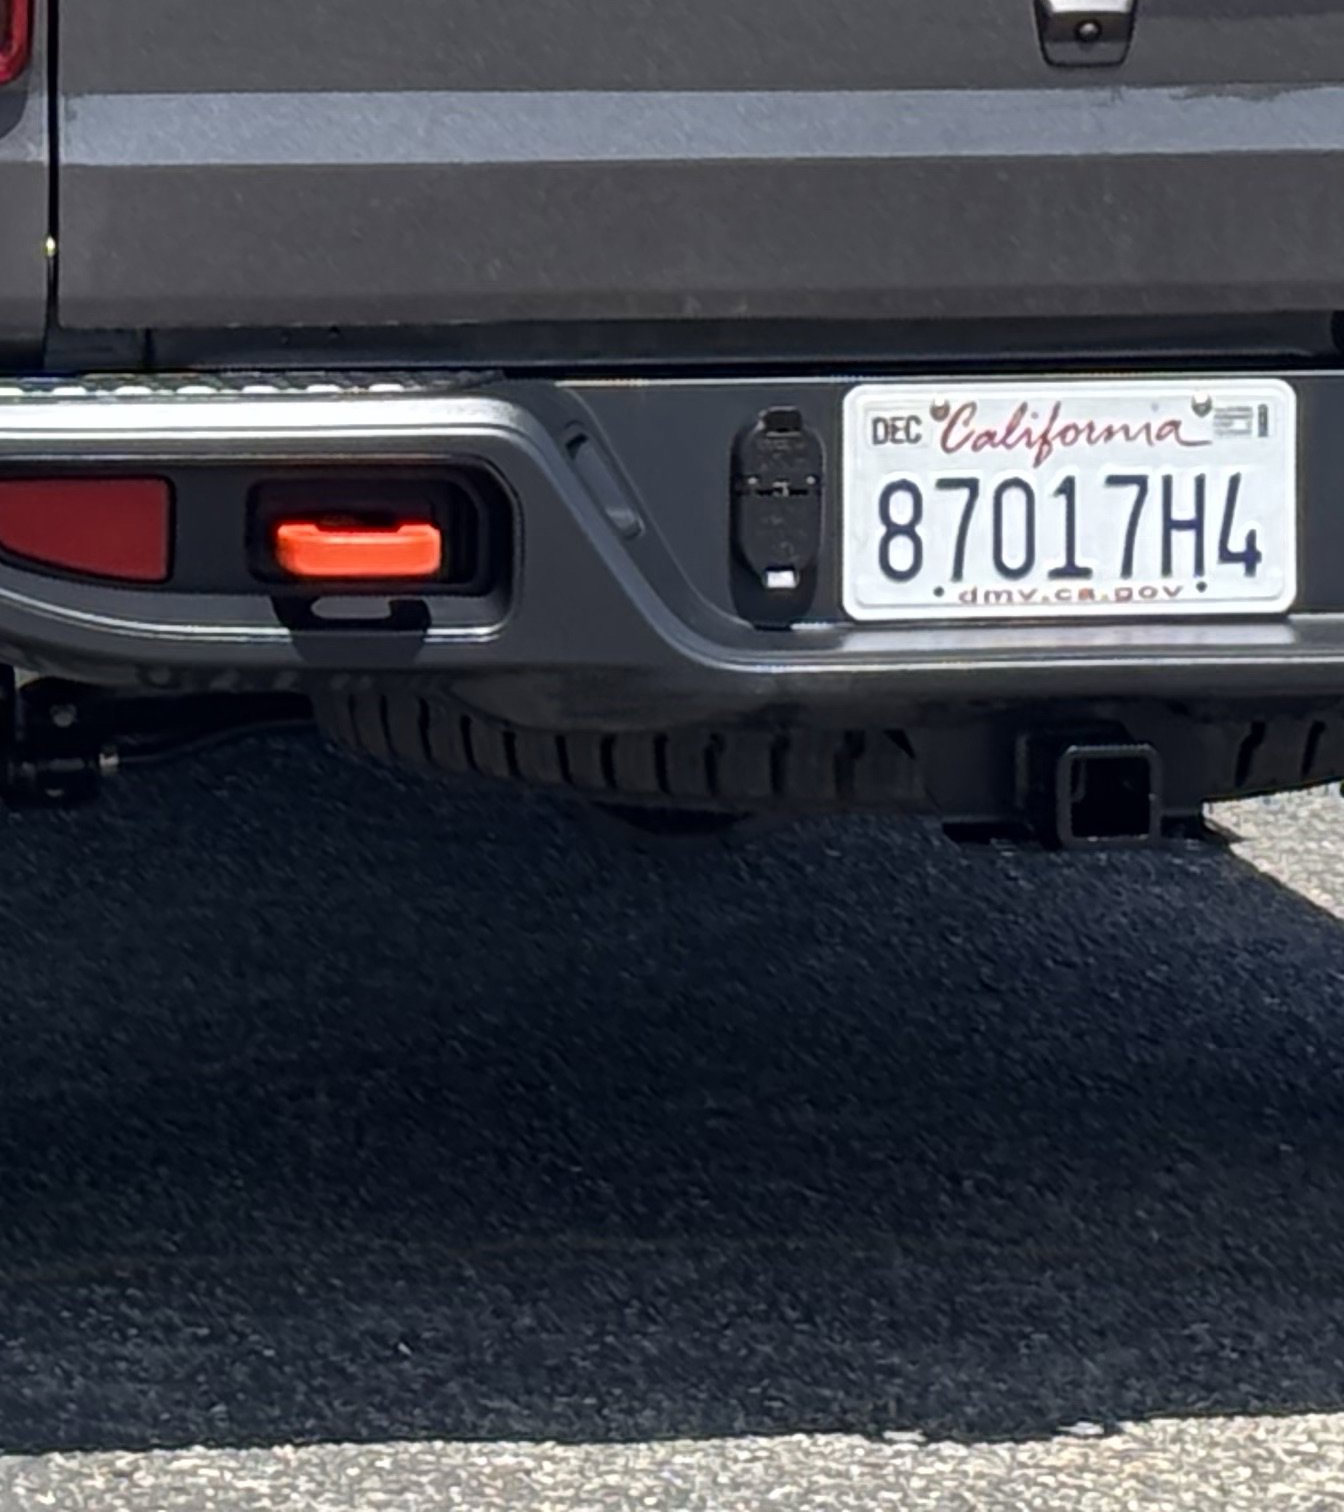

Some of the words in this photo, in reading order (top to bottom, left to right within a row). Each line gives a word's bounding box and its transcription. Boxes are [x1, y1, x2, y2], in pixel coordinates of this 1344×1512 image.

[871, 415, 923, 446] DEC
[939, 399, 1212, 469] California
[876, 472, 1263, 583] 87017H4
[957, 586, 1183, 605] dmv.ca.gov
